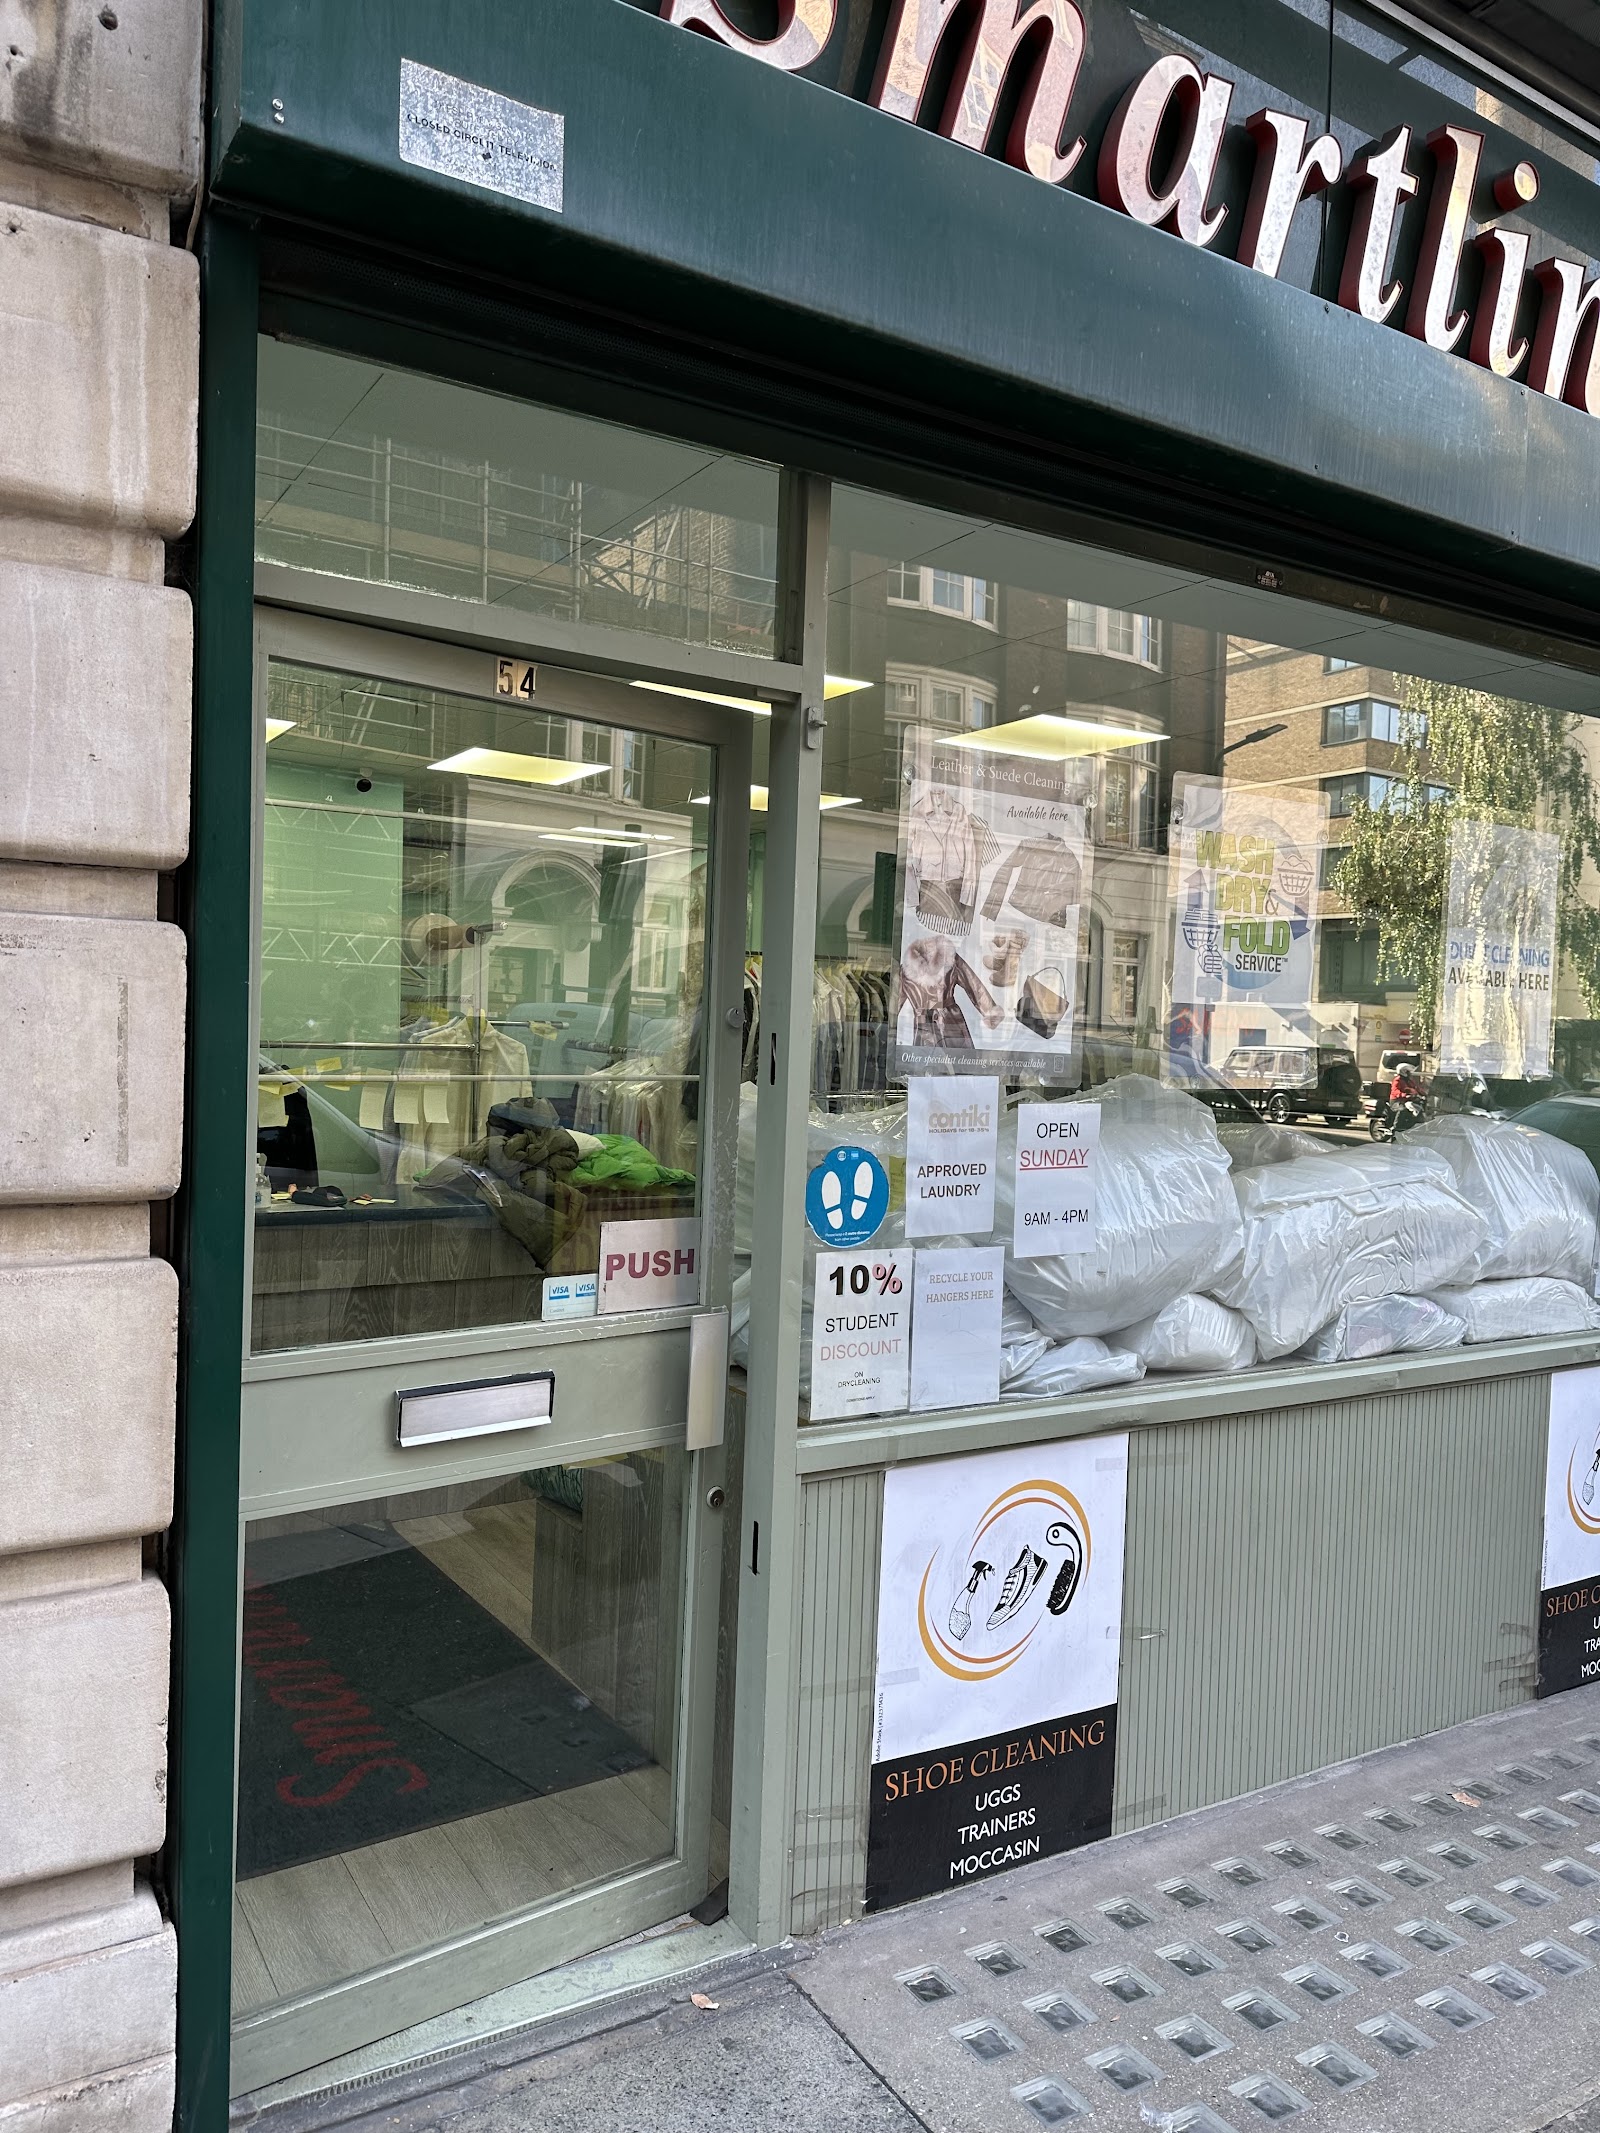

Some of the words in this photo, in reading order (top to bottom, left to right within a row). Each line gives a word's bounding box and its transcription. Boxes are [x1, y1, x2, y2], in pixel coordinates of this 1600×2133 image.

[499, 660, 536, 699] 54
[931, 756, 974, 775] Leather
[976, 763, 986, 777] &
[989, 766, 1021, 783] Suede
[1023, 772, 1071, 795] Cleaning
[1006, 806, 1047, 820] Available
[1048, 807, 1069, 822] here
[1196, 830, 1275, 875] WASH
[1214, 873, 1272, 914] DRY
[1223, 916, 1291, 955] FOLD
[1491, 944, 1550, 968] CLENING
[1518, 972, 1550, 991] HERE
[901, 1052, 922, 1063] Other
[924, 1055, 956, 1066] specialist
[957, 1056, 988, 1068] cleaning
[989, 1059, 1014, 1068] services
[1015, 1059, 1047, 1069] available
[928, 1104, 990, 1128] contiki
[1036, 1122, 1080, 1139] OPEN
[1019, 1148, 1090, 1168] SUNDAY
[917, 1163, 987, 1179] APPROVED
[920, 1184, 981, 1199] LAUNDRY
[1024, 1212, 1051, 1227] 9AM
[1061, 1209, 1089, 1225] 4PM
[605, 1248, 695, 1281] PUSH
[552, 1286, 569, 1294] VISA
[579, 1283, 595, 1292] VISA
[829, 1263, 903, 1296] 10%
[929, 1273, 969, 1285] RECYCLE
[971, 1271, 994, 1282] YOUR
[926, 1292, 970, 1304] HANGERS
[971, 1290, 994, 1300] HERE
[825, 1312, 900, 1334] STUDENT
[820, 1339, 902, 1362] DISCOUNT
[838, 1377, 881, 1388] DRYCLEANING
[1546, 1589, 1589, 1618] SHOE
[885, 1757, 964, 1801] SHOE
[970, 1720, 1105, 1778] CLEANING
[974, 1783, 1021, 1812] UGGS
[957, 1807, 1036, 1845] TRAINERS
[950, 1835, 1040, 1880] MOCCASIN
